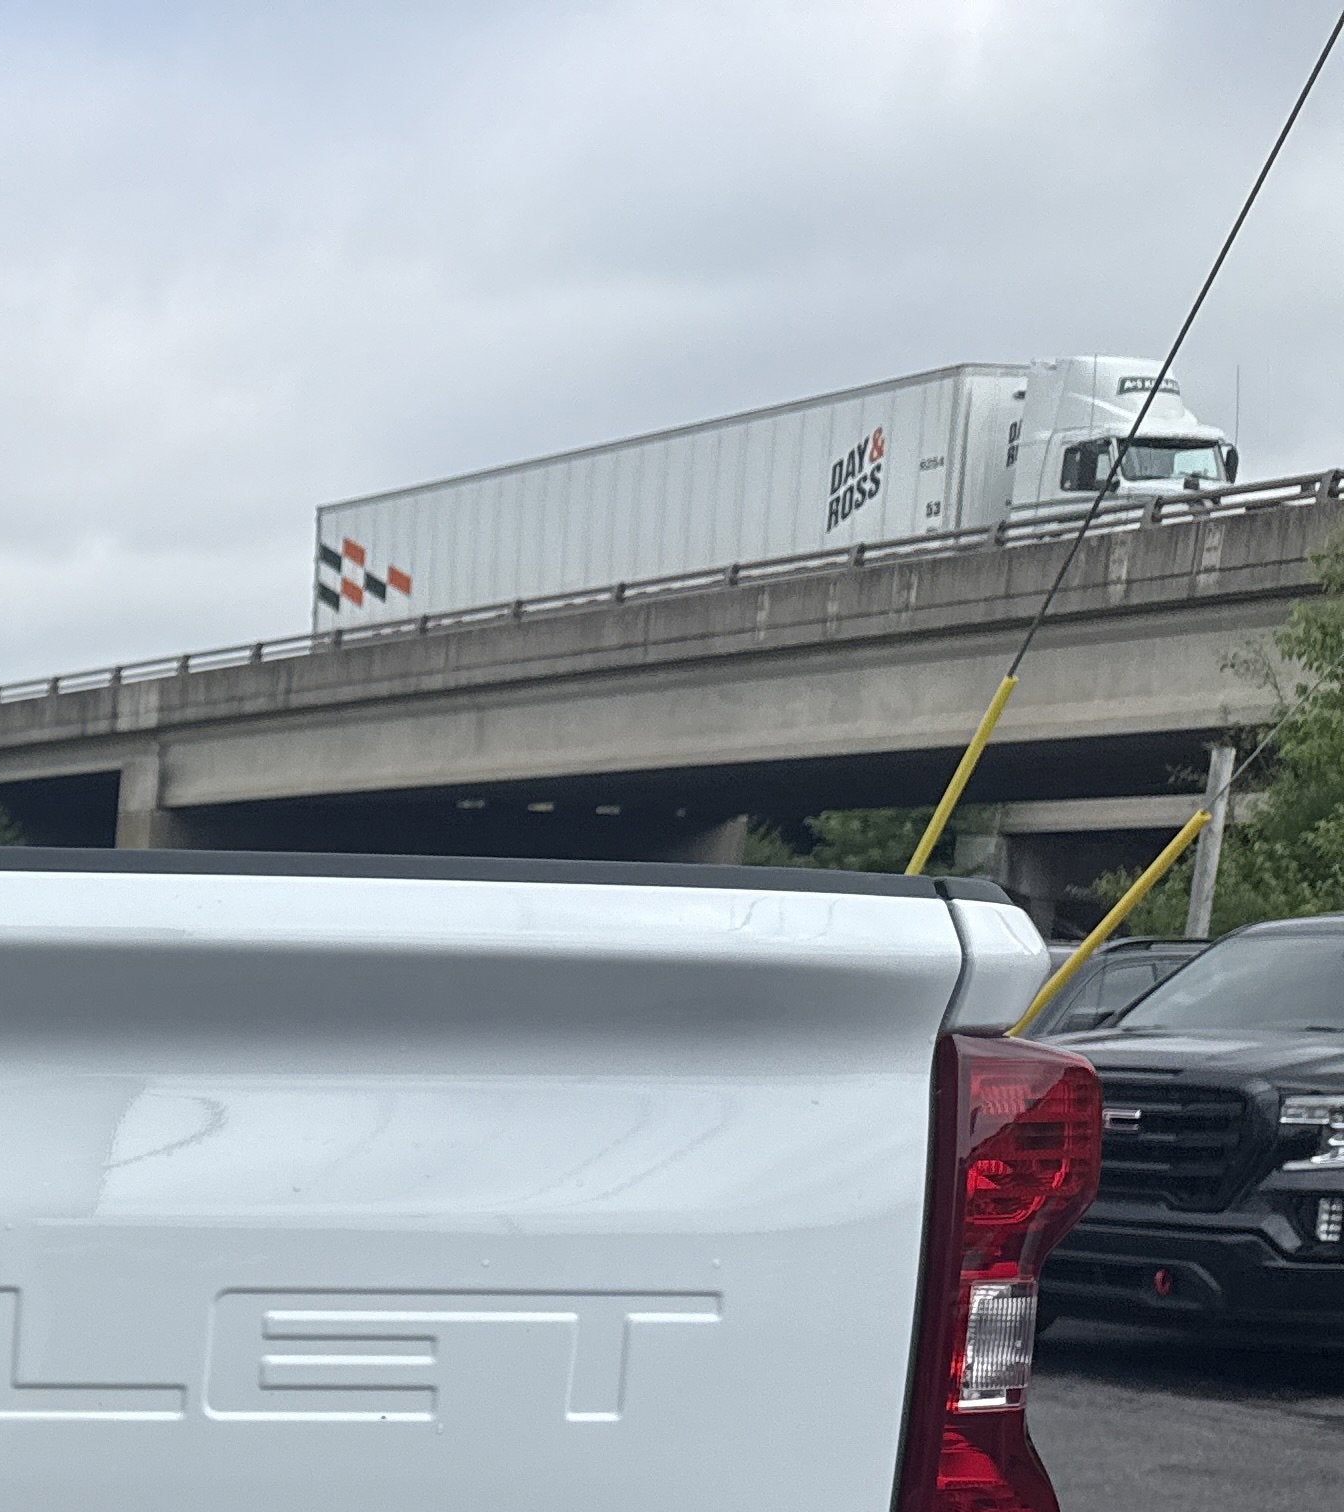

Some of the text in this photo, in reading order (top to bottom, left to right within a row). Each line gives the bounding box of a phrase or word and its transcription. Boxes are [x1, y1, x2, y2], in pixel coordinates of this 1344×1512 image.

[830, 426, 884, 495] DAY &
[825, 462, 881, 534] ROSS
